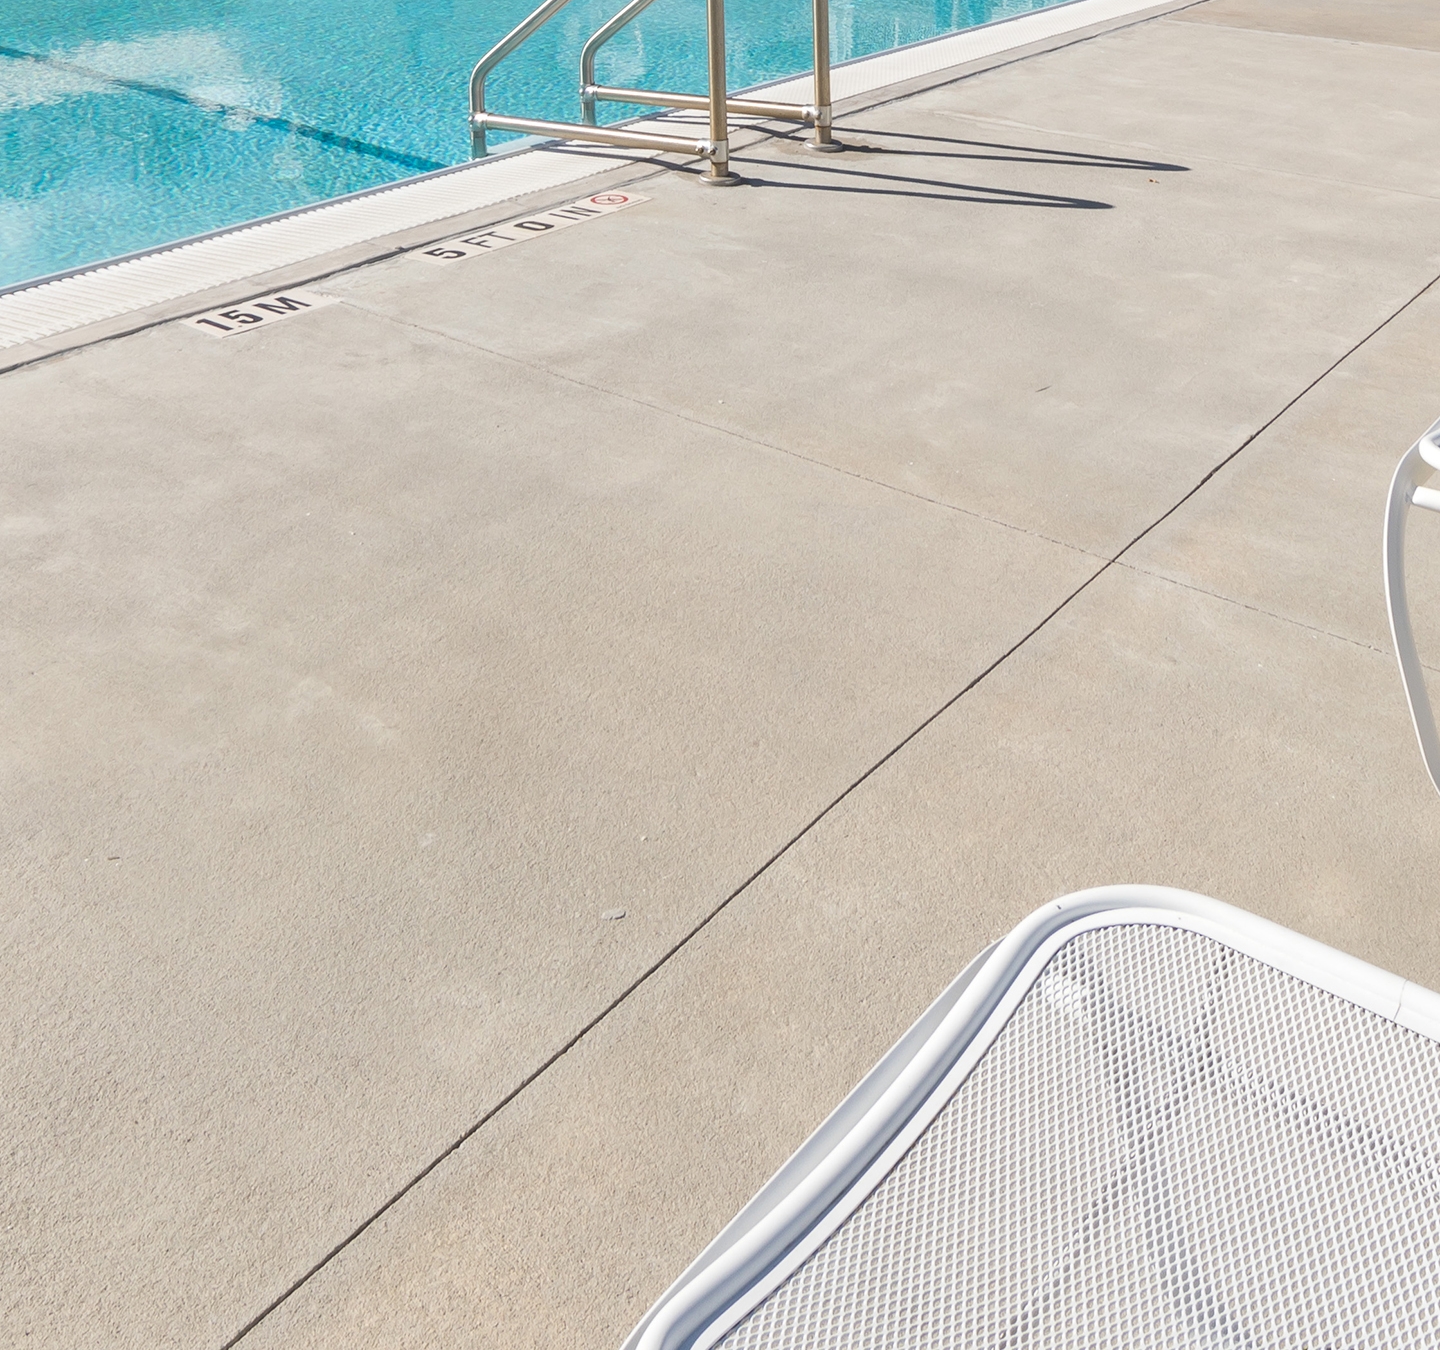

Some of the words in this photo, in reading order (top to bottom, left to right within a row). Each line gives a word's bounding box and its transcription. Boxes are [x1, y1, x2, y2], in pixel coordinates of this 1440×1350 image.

[424, 247, 467, 259] 5
[461, 231, 516, 248] FT
[549, 206, 602, 221] IN
[252, 296, 312, 315] M
